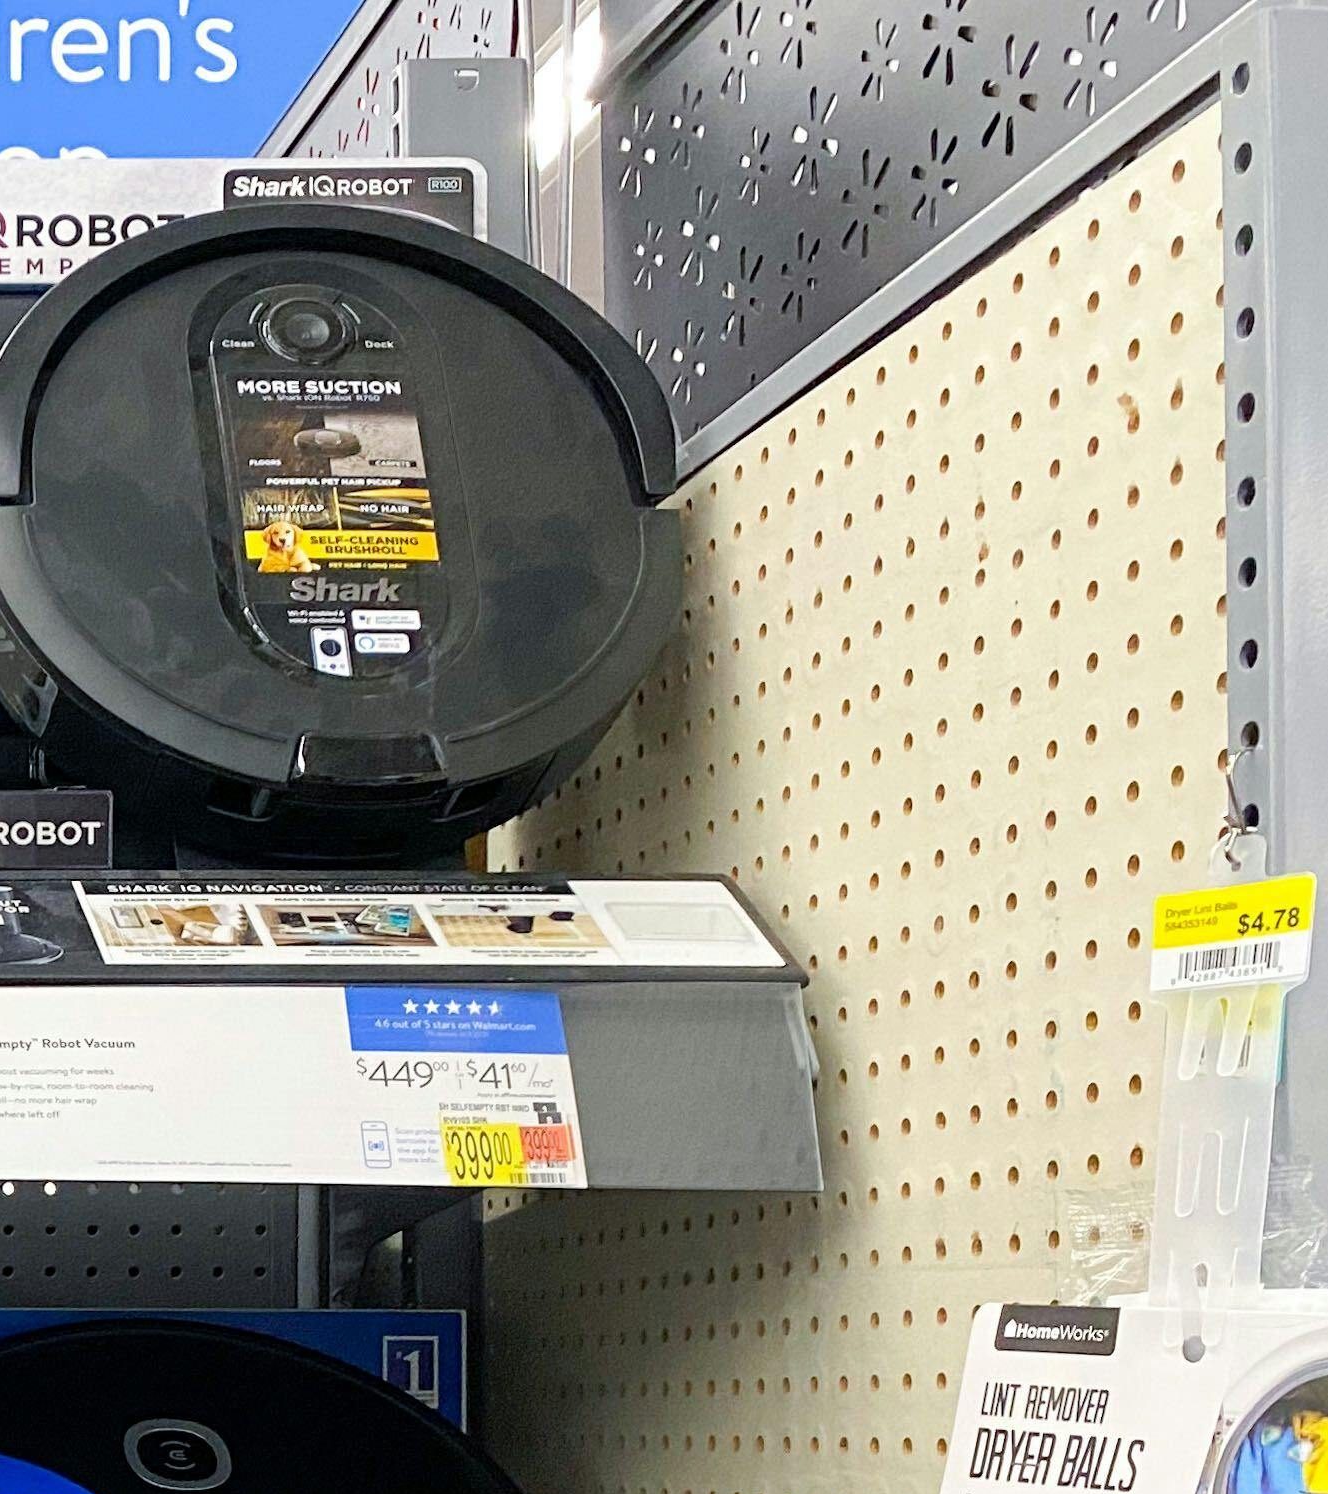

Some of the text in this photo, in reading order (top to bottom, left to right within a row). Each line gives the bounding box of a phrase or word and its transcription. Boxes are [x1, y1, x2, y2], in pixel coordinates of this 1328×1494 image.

[233, 175, 306, 197] Shark
[16, 214, 185, 247] ROBO
[222, 340, 254, 348] Clean
[365, 340, 393, 348] Dock
[237, 380, 401, 395] MORE SUCTION
[310, 536, 419, 545] SELF-CLEANING
[325, 545, 406, 554] BRUSHROLL
[289, 576, 401, 604] Shark
[206, 884, 322, 893] NAVIGATION
[1237, 907, 1300, 935] $4.78
[42, 1039, 81, 1048] Robot
[84, 1039, 135, 1048] Vacuum
[981, 1382, 1110, 1424] LINT REMOVER
[969, 1427, 1145, 1492] DRYER BALLS
